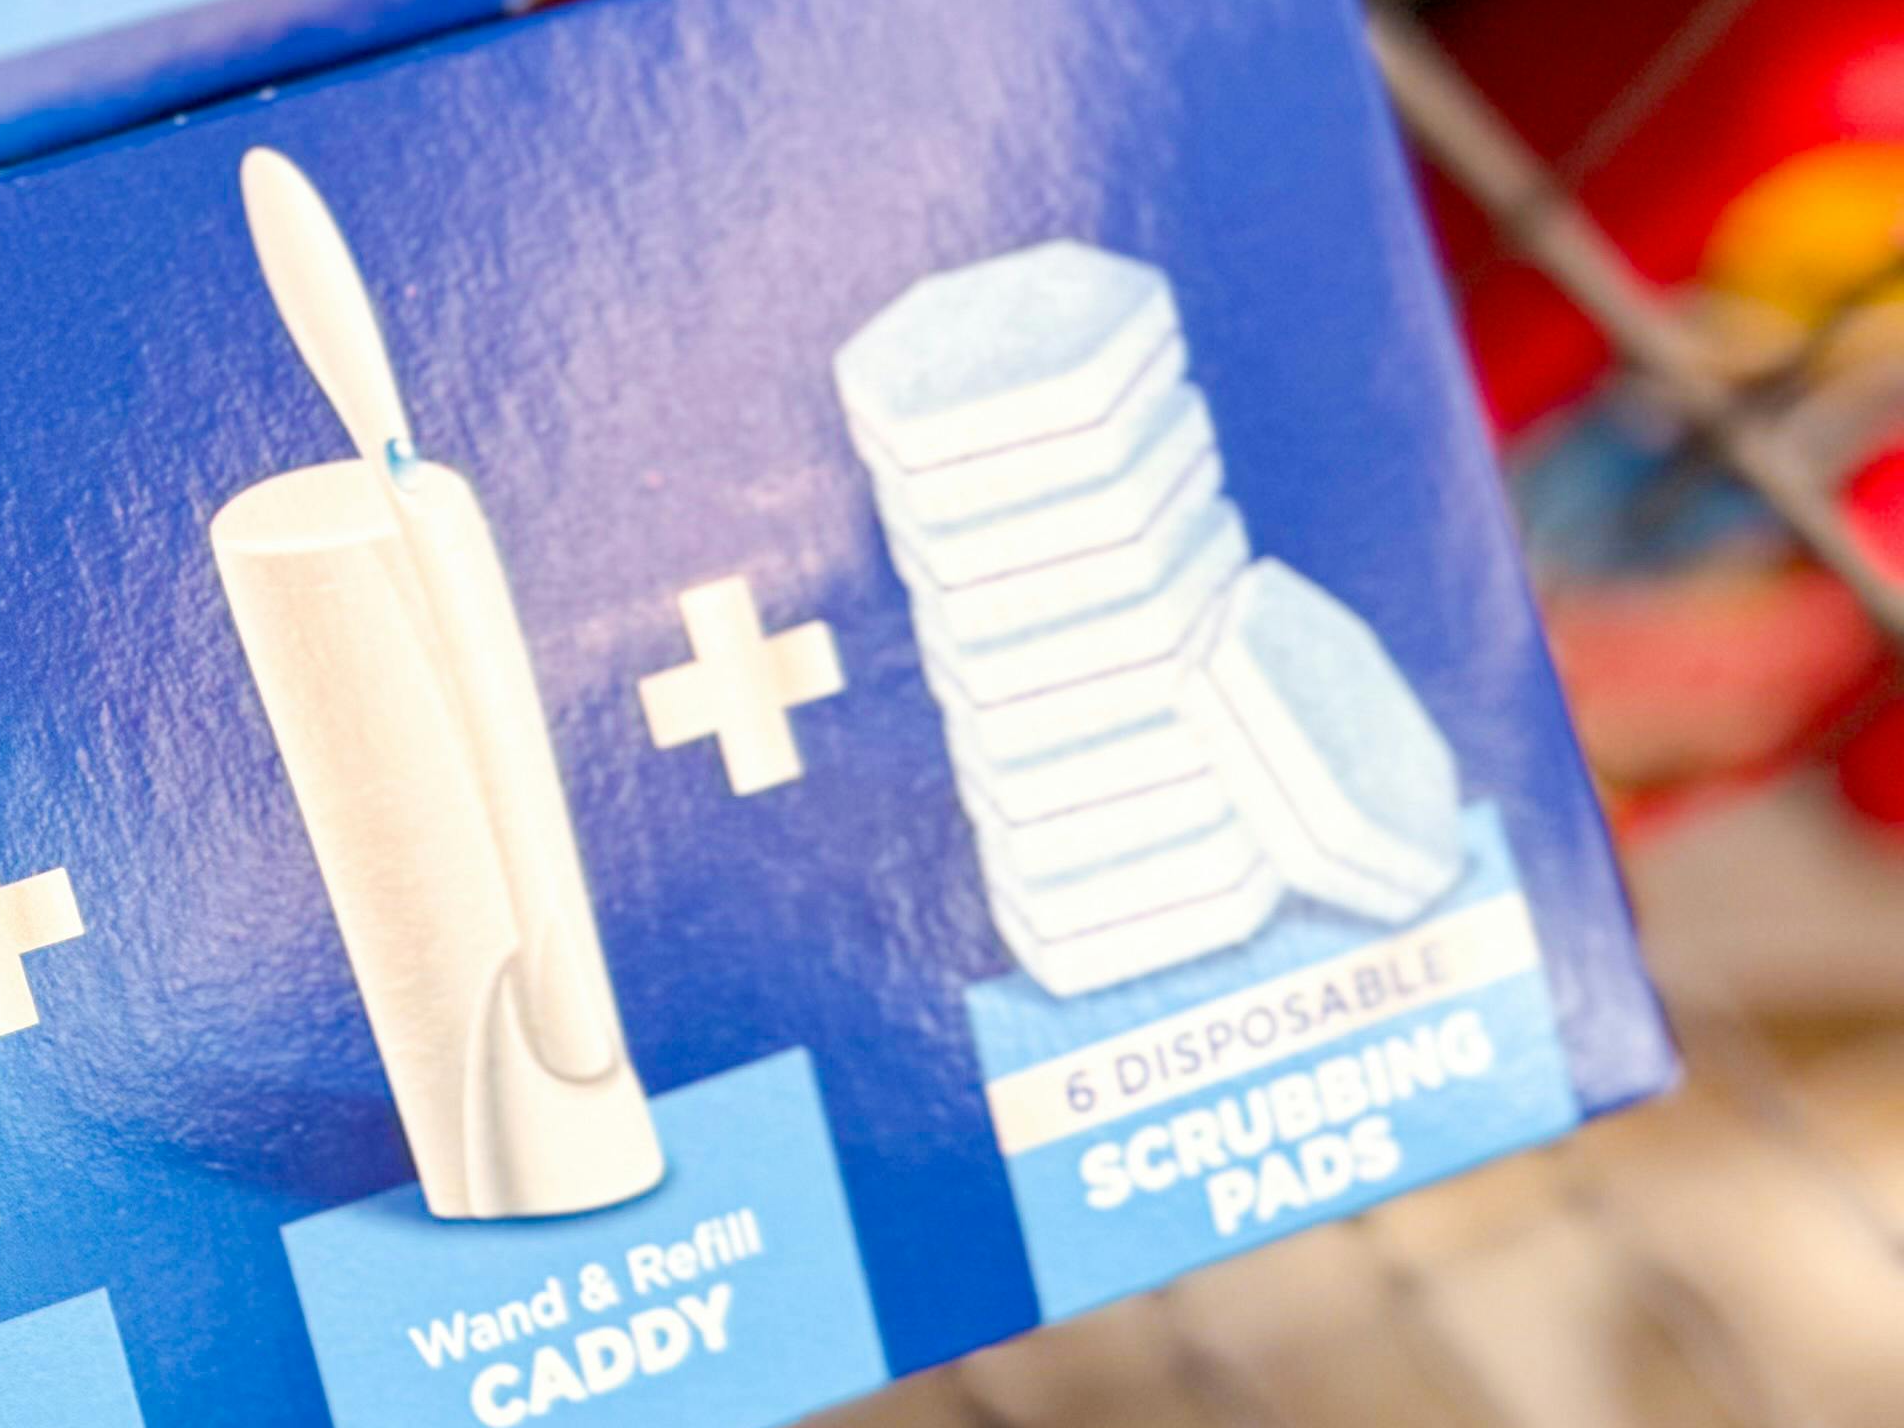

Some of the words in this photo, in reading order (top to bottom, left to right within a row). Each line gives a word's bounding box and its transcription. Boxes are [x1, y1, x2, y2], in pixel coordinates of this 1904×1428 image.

[1065, 1070, 1096, 1114] 6
[1114, 946, 1444, 1098] DISPOSABLE
[1081, 1007, 1497, 1208] SCRUBBING
[1206, 1115, 1401, 1234] PADS
[407, 1276, 570, 1369] Wand
[579, 1262, 621, 1312] &
[626, 1208, 763, 1294] Refill
[470, 1282, 732, 1428] CADDY
